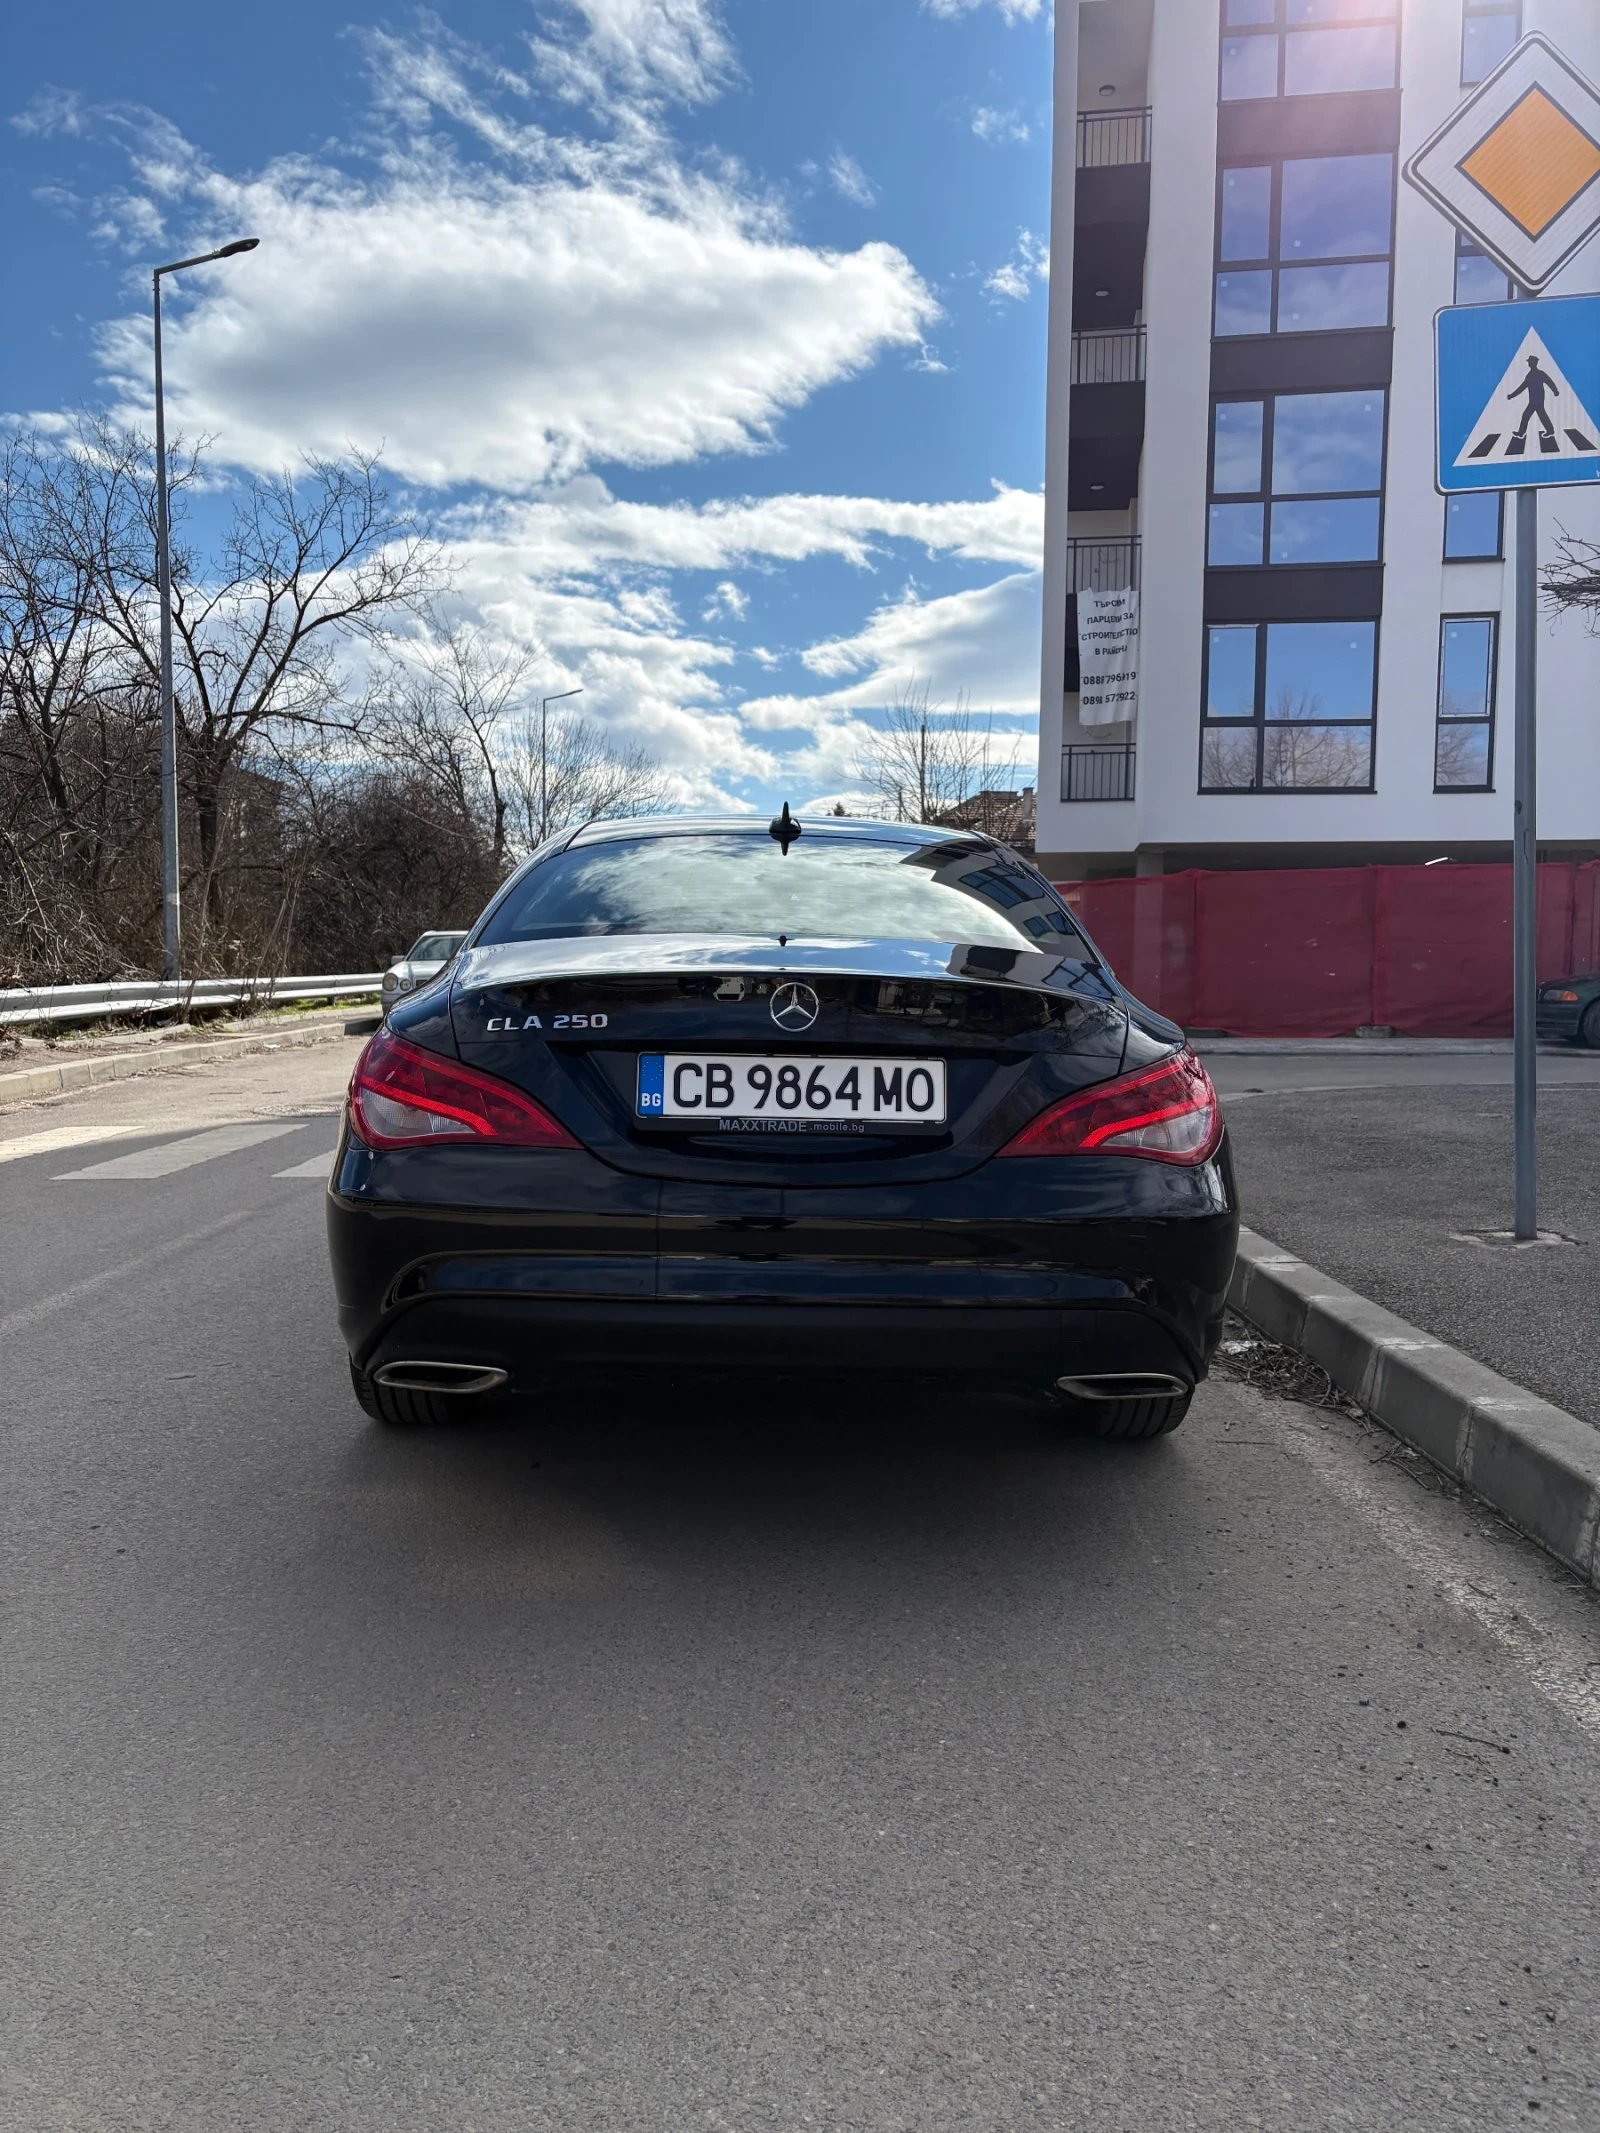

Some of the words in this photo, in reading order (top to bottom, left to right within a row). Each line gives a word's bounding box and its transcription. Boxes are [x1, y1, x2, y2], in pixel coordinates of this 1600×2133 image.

[1123, 612, 1134, 620] ЗА
[1094, 647, 1101, 656] В
[486, 1015, 543, 1031] CLA
[553, 1013, 608, 1029] 250
[673, 1062, 735, 1108] CB
[747, 1064, 861, 1111] 9864
[873, 1066, 935, 1112] MO
[641, 1093, 662, 1107] BG
[719, 1119, 807, 1132] MAXXTRADE
